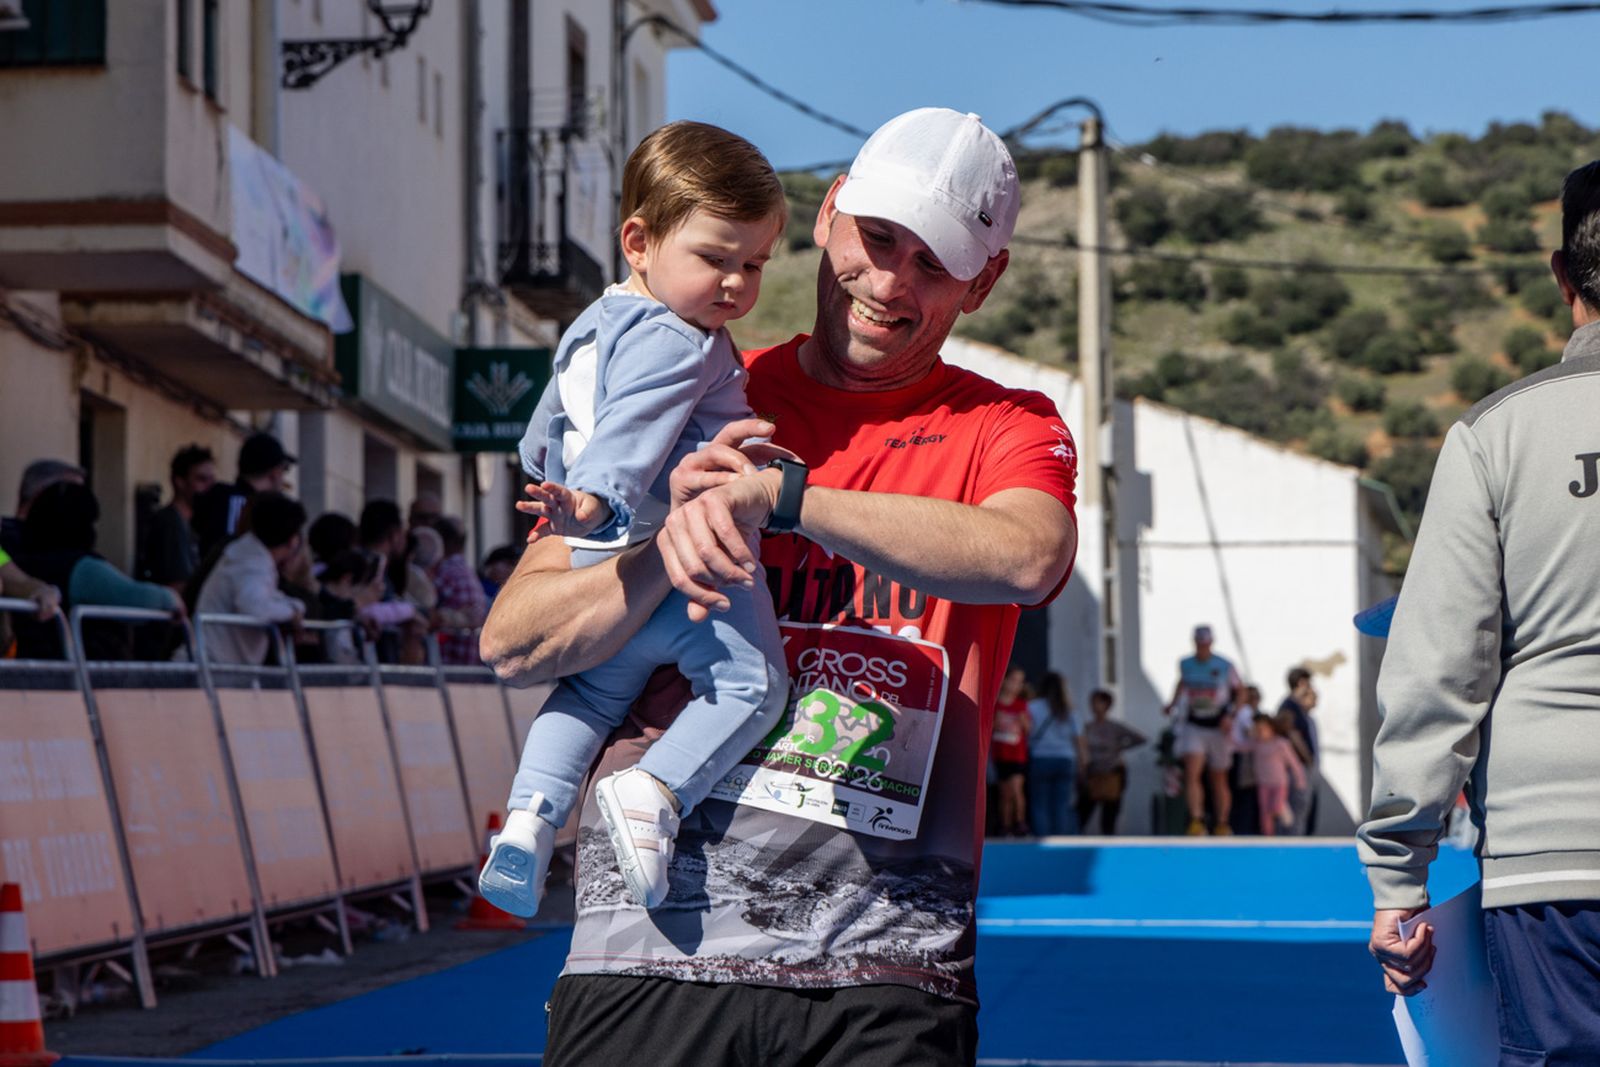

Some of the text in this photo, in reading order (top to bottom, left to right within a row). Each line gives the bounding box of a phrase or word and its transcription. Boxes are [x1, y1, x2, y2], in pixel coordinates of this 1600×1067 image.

[797, 647, 908, 688] CROSS
[788, 671, 902, 706] NTANO DEL
[764, 752, 803, 766] JAVIER
